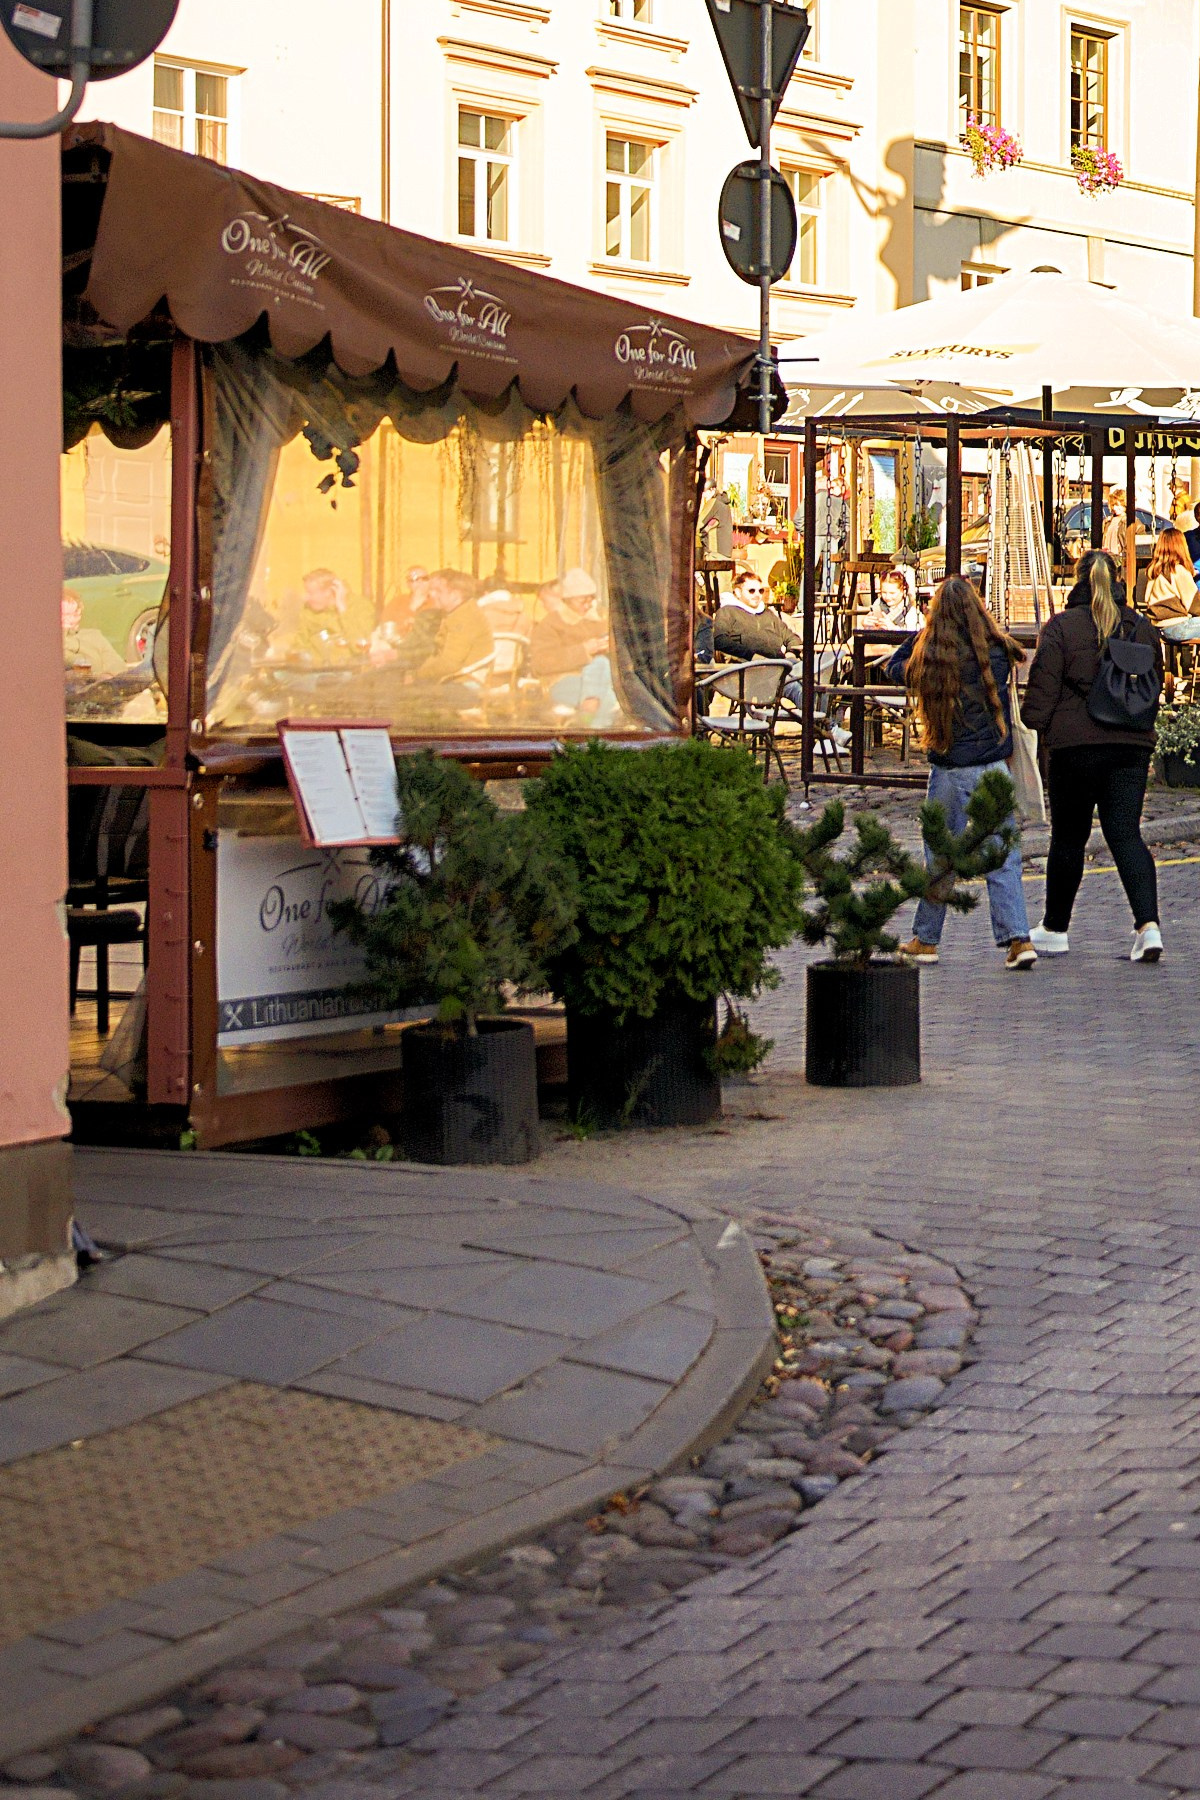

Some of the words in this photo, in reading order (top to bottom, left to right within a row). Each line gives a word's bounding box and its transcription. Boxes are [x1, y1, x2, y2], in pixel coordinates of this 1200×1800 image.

[221, 219, 270, 254] One
[288, 240, 332, 279] All
[423, 295, 458, 322] One
[457, 300, 475, 327] for
[478, 303, 511, 338] All
[615, 334, 646, 363] One
[648, 338, 665, 364] for
[668, 340, 697, 371] All
[260, 884, 312, 932] One
[251, 995, 345, 1027] Lithuanian
